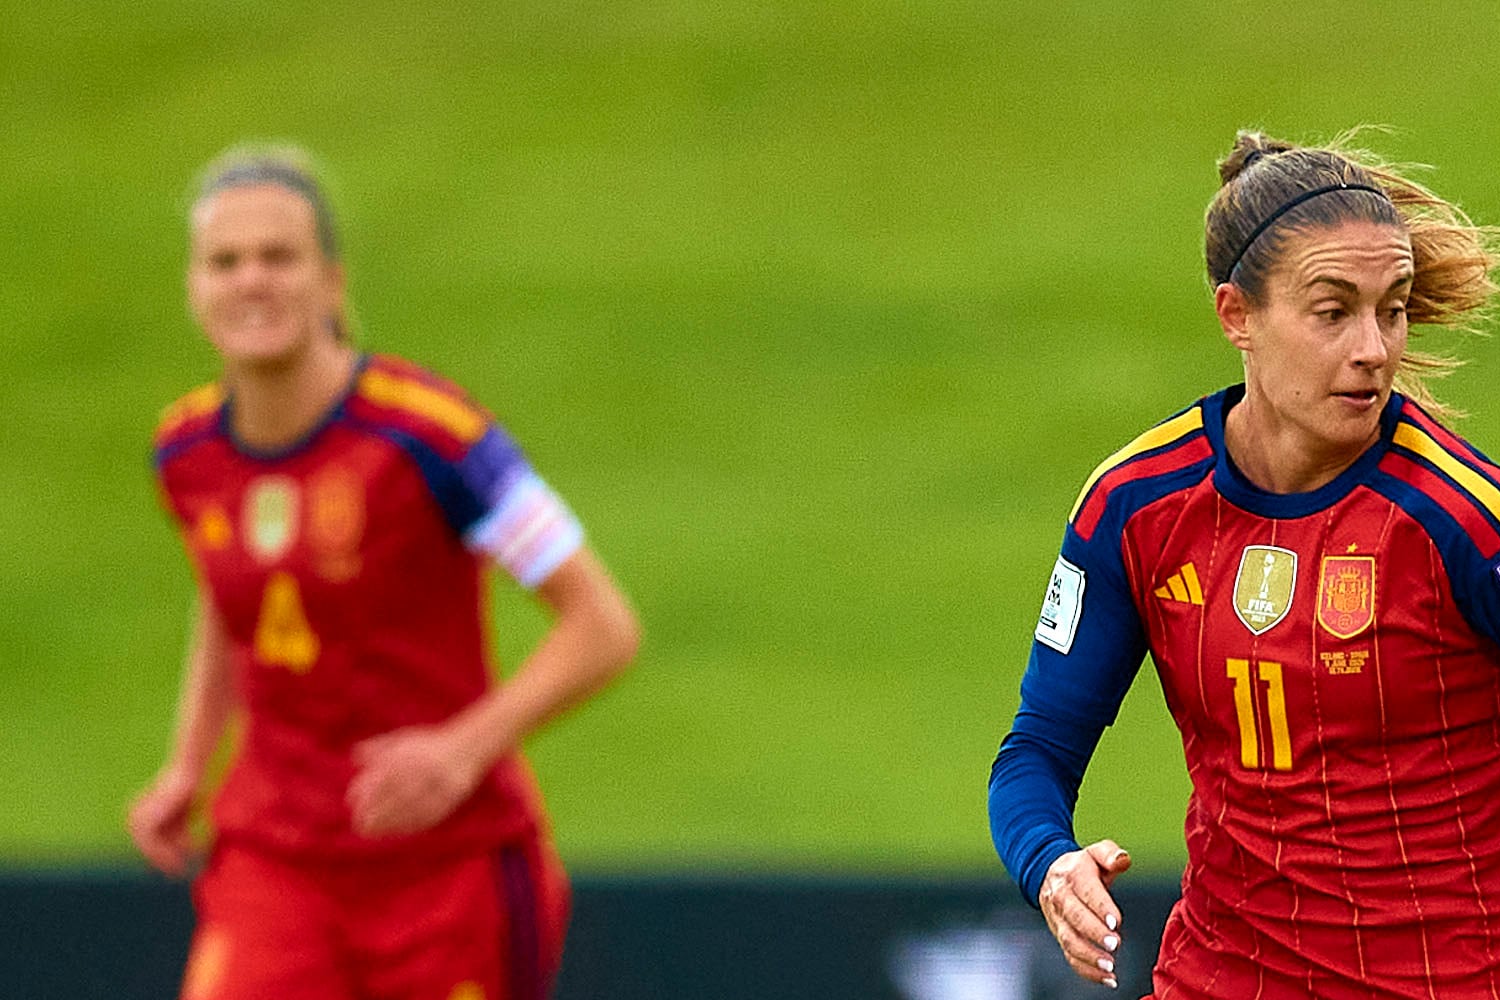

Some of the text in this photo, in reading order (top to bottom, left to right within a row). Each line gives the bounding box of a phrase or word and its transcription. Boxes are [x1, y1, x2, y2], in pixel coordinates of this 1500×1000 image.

[254, 572, 320, 674] 4
[1247, 598, 1275, 613] FIFA
[1226, 658, 1293, 771] 11
